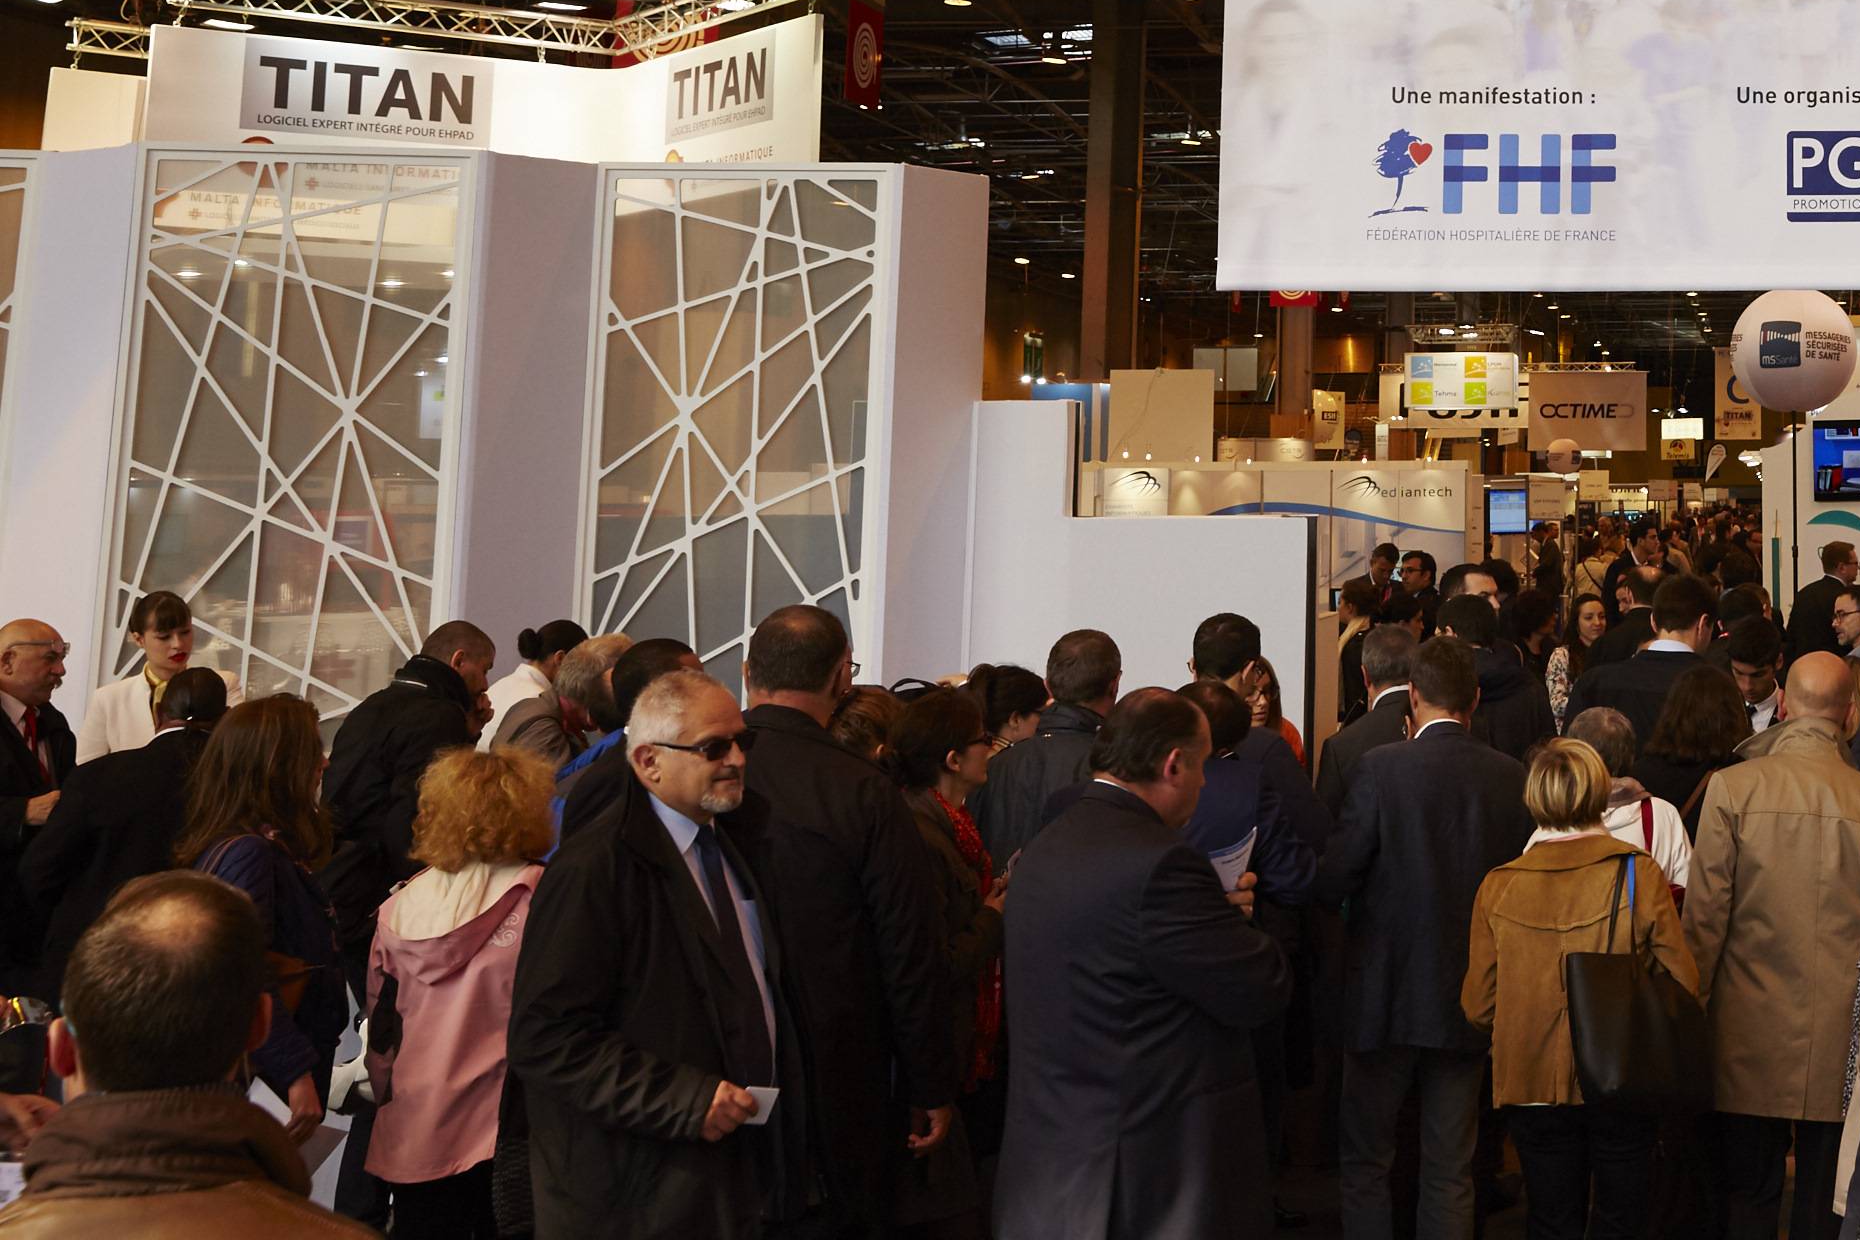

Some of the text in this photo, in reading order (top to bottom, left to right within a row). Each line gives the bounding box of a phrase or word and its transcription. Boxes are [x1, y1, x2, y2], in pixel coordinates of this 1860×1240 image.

[260, 56, 474, 124] TITAN
[674, 48, 766, 119] TITAN
[1391, 87, 1432, 105] Une
[1439, 86, 1583, 105] manifestation
[1736, 87, 1777, 104] Une
[257, 114, 474, 141] LOGICIEL EXPERT INTÉGRÉ POUR EHPAD
[1442, 133, 1617, 214] FHF
[1366, 227, 1617, 241] FÉDÉRATION HOSPITALIÈRE DE FRANCE
[1805, 350, 1841, 361] DE SANTÉ
